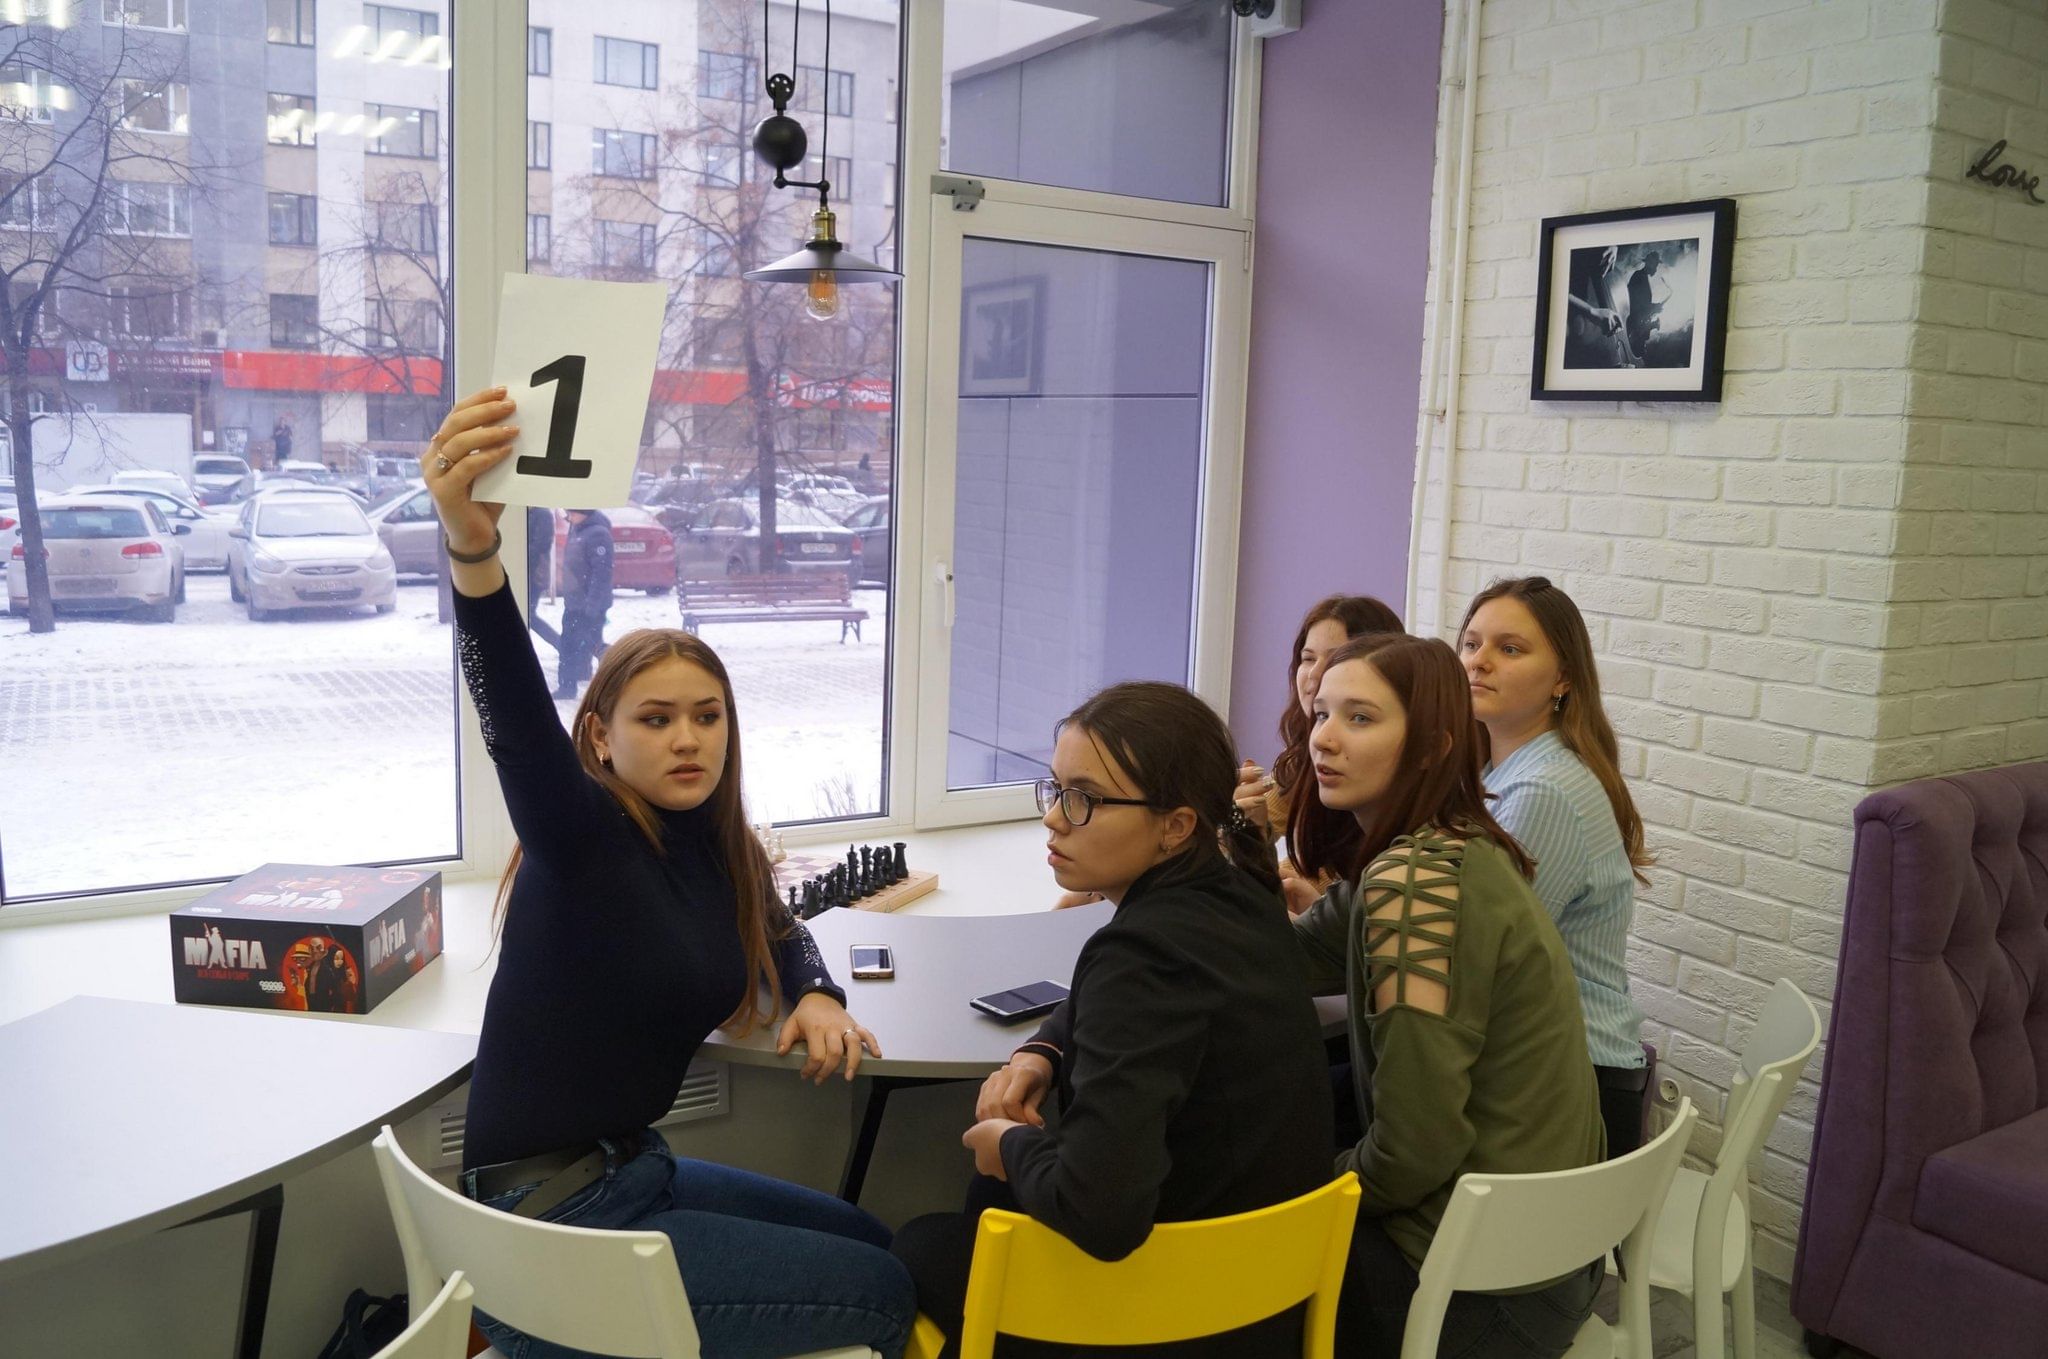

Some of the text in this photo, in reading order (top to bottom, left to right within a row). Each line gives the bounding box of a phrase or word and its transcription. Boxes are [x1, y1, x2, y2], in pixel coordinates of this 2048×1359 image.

[1966, 139, 2046, 204] love
[516, 355, 592, 478] 1
[183, 924, 268, 970] MAFIA
[370, 918, 407, 969] MAFIA
